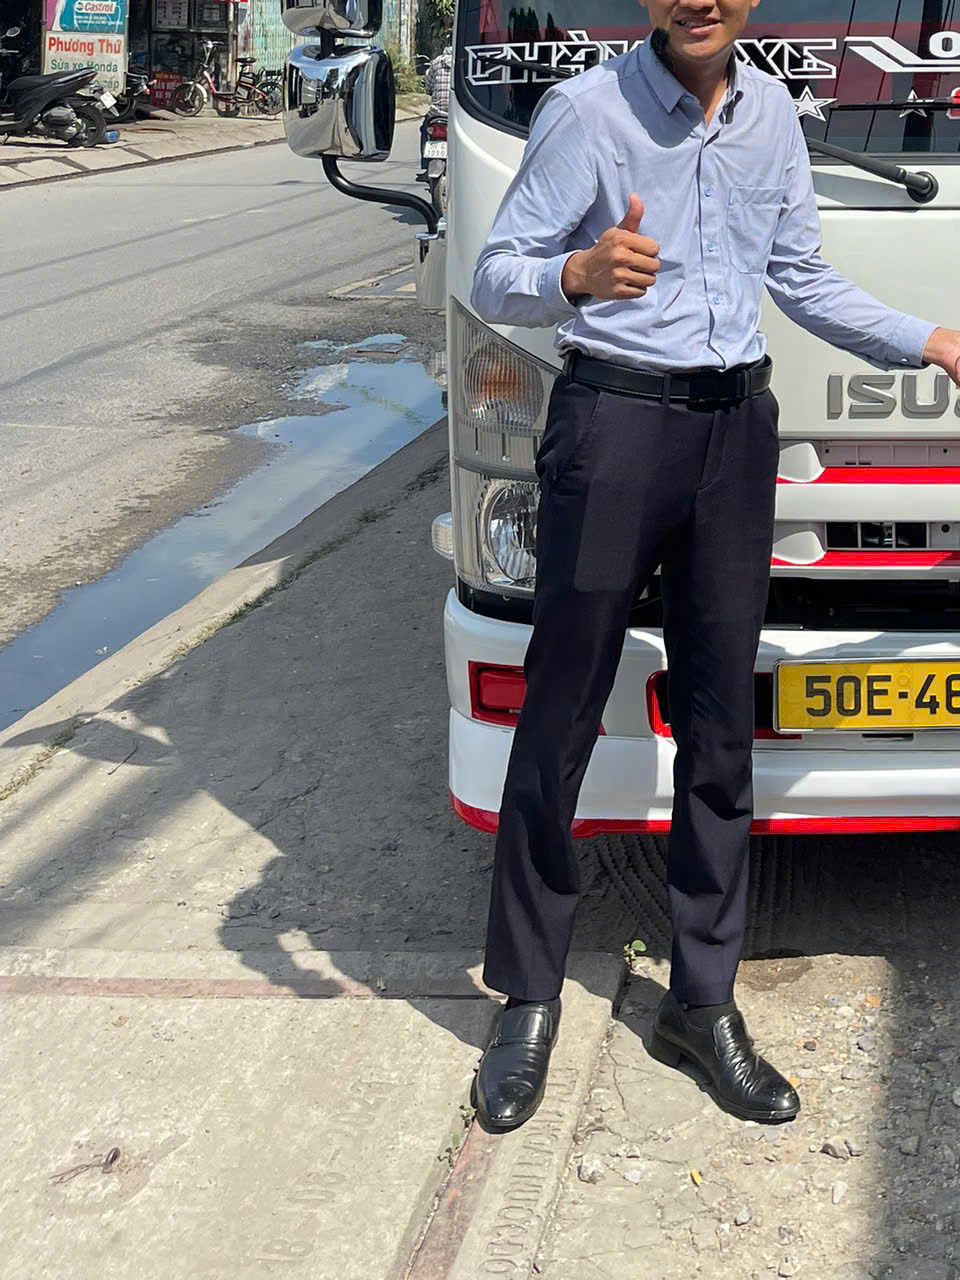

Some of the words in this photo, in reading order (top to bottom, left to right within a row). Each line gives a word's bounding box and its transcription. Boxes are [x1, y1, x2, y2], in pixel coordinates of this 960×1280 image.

[84, 2, 113, 12] Castrol
[48, 37, 95, 56] Phương
[51, 58, 70, 70] Sửa
[72, 62, 84, 71] xe
